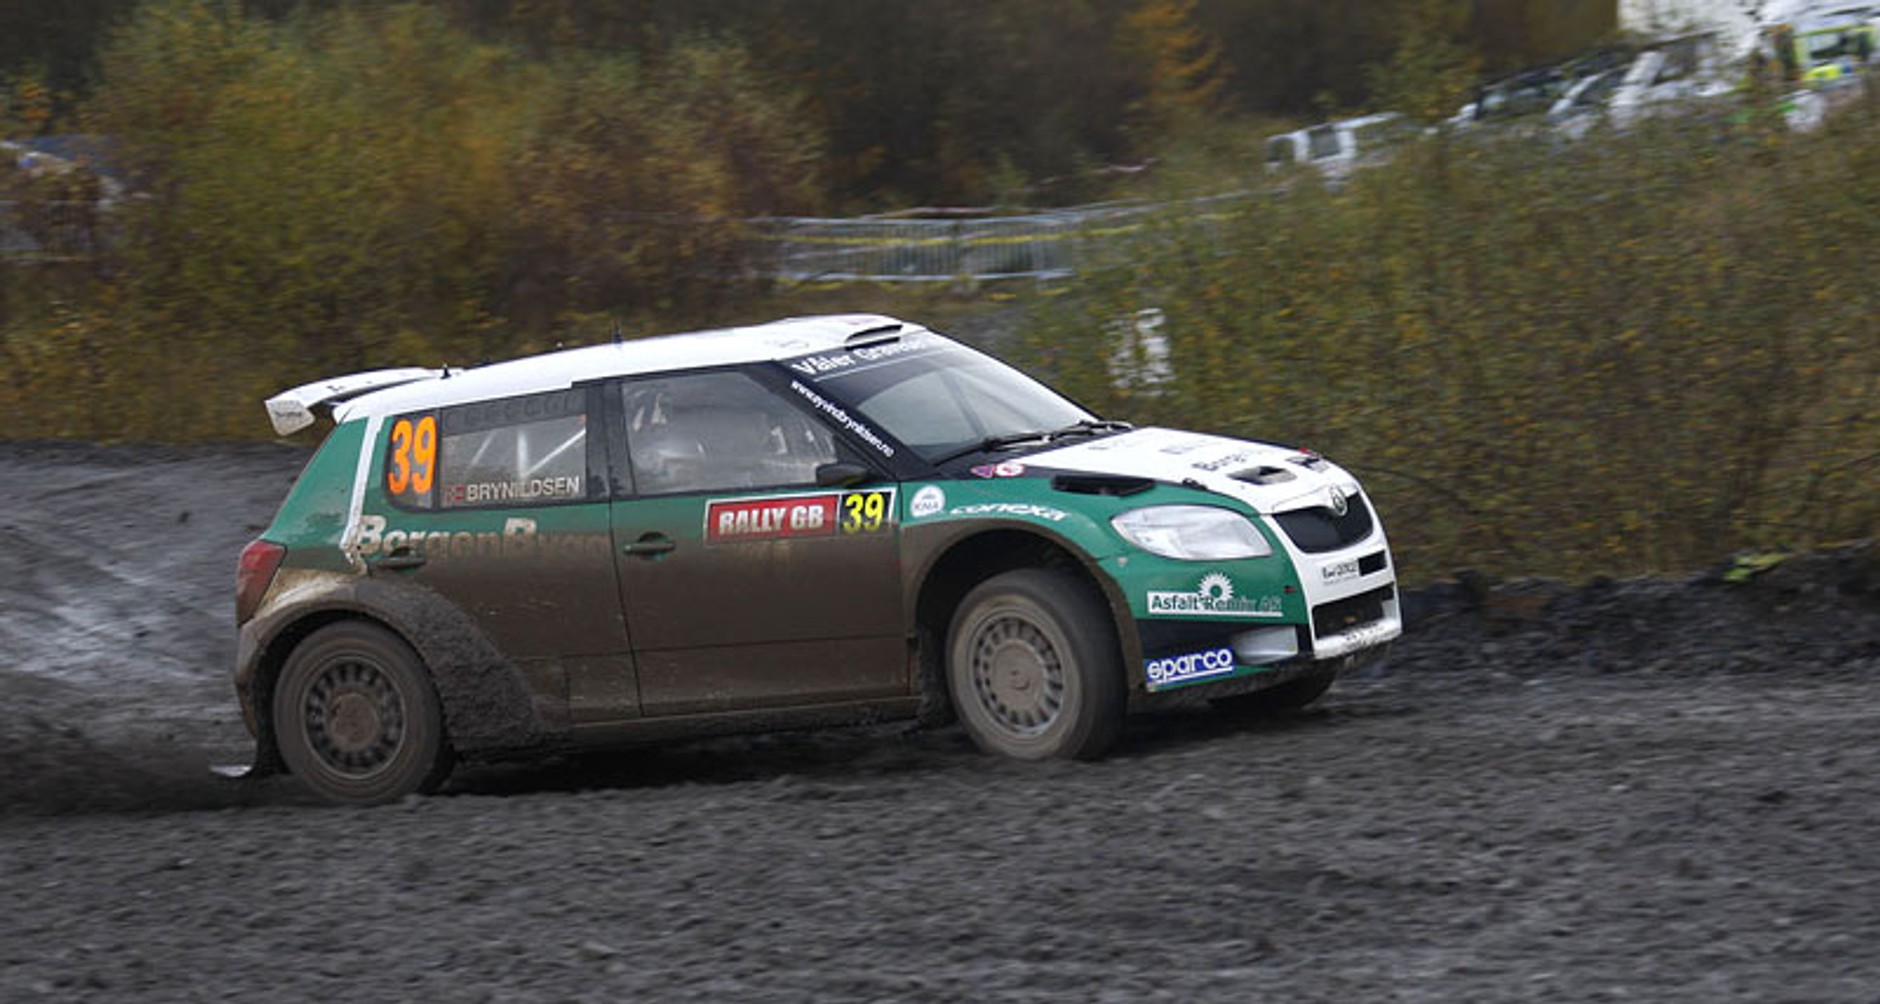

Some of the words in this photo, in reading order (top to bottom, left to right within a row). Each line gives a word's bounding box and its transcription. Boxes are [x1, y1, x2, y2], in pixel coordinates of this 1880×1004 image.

[387, 415, 437, 495] 39
[467, 475, 580, 501] BRYNILDSEN
[718, 507, 787, 536] RALLY
[789, 505, 825, 530] GB
[842, 492, 885, 535] 39
[950, 502, 1067, 522] conexa
[1151, 594, 1199, 611] Asfalt
[1147, 648, 1233, 682] sparco
